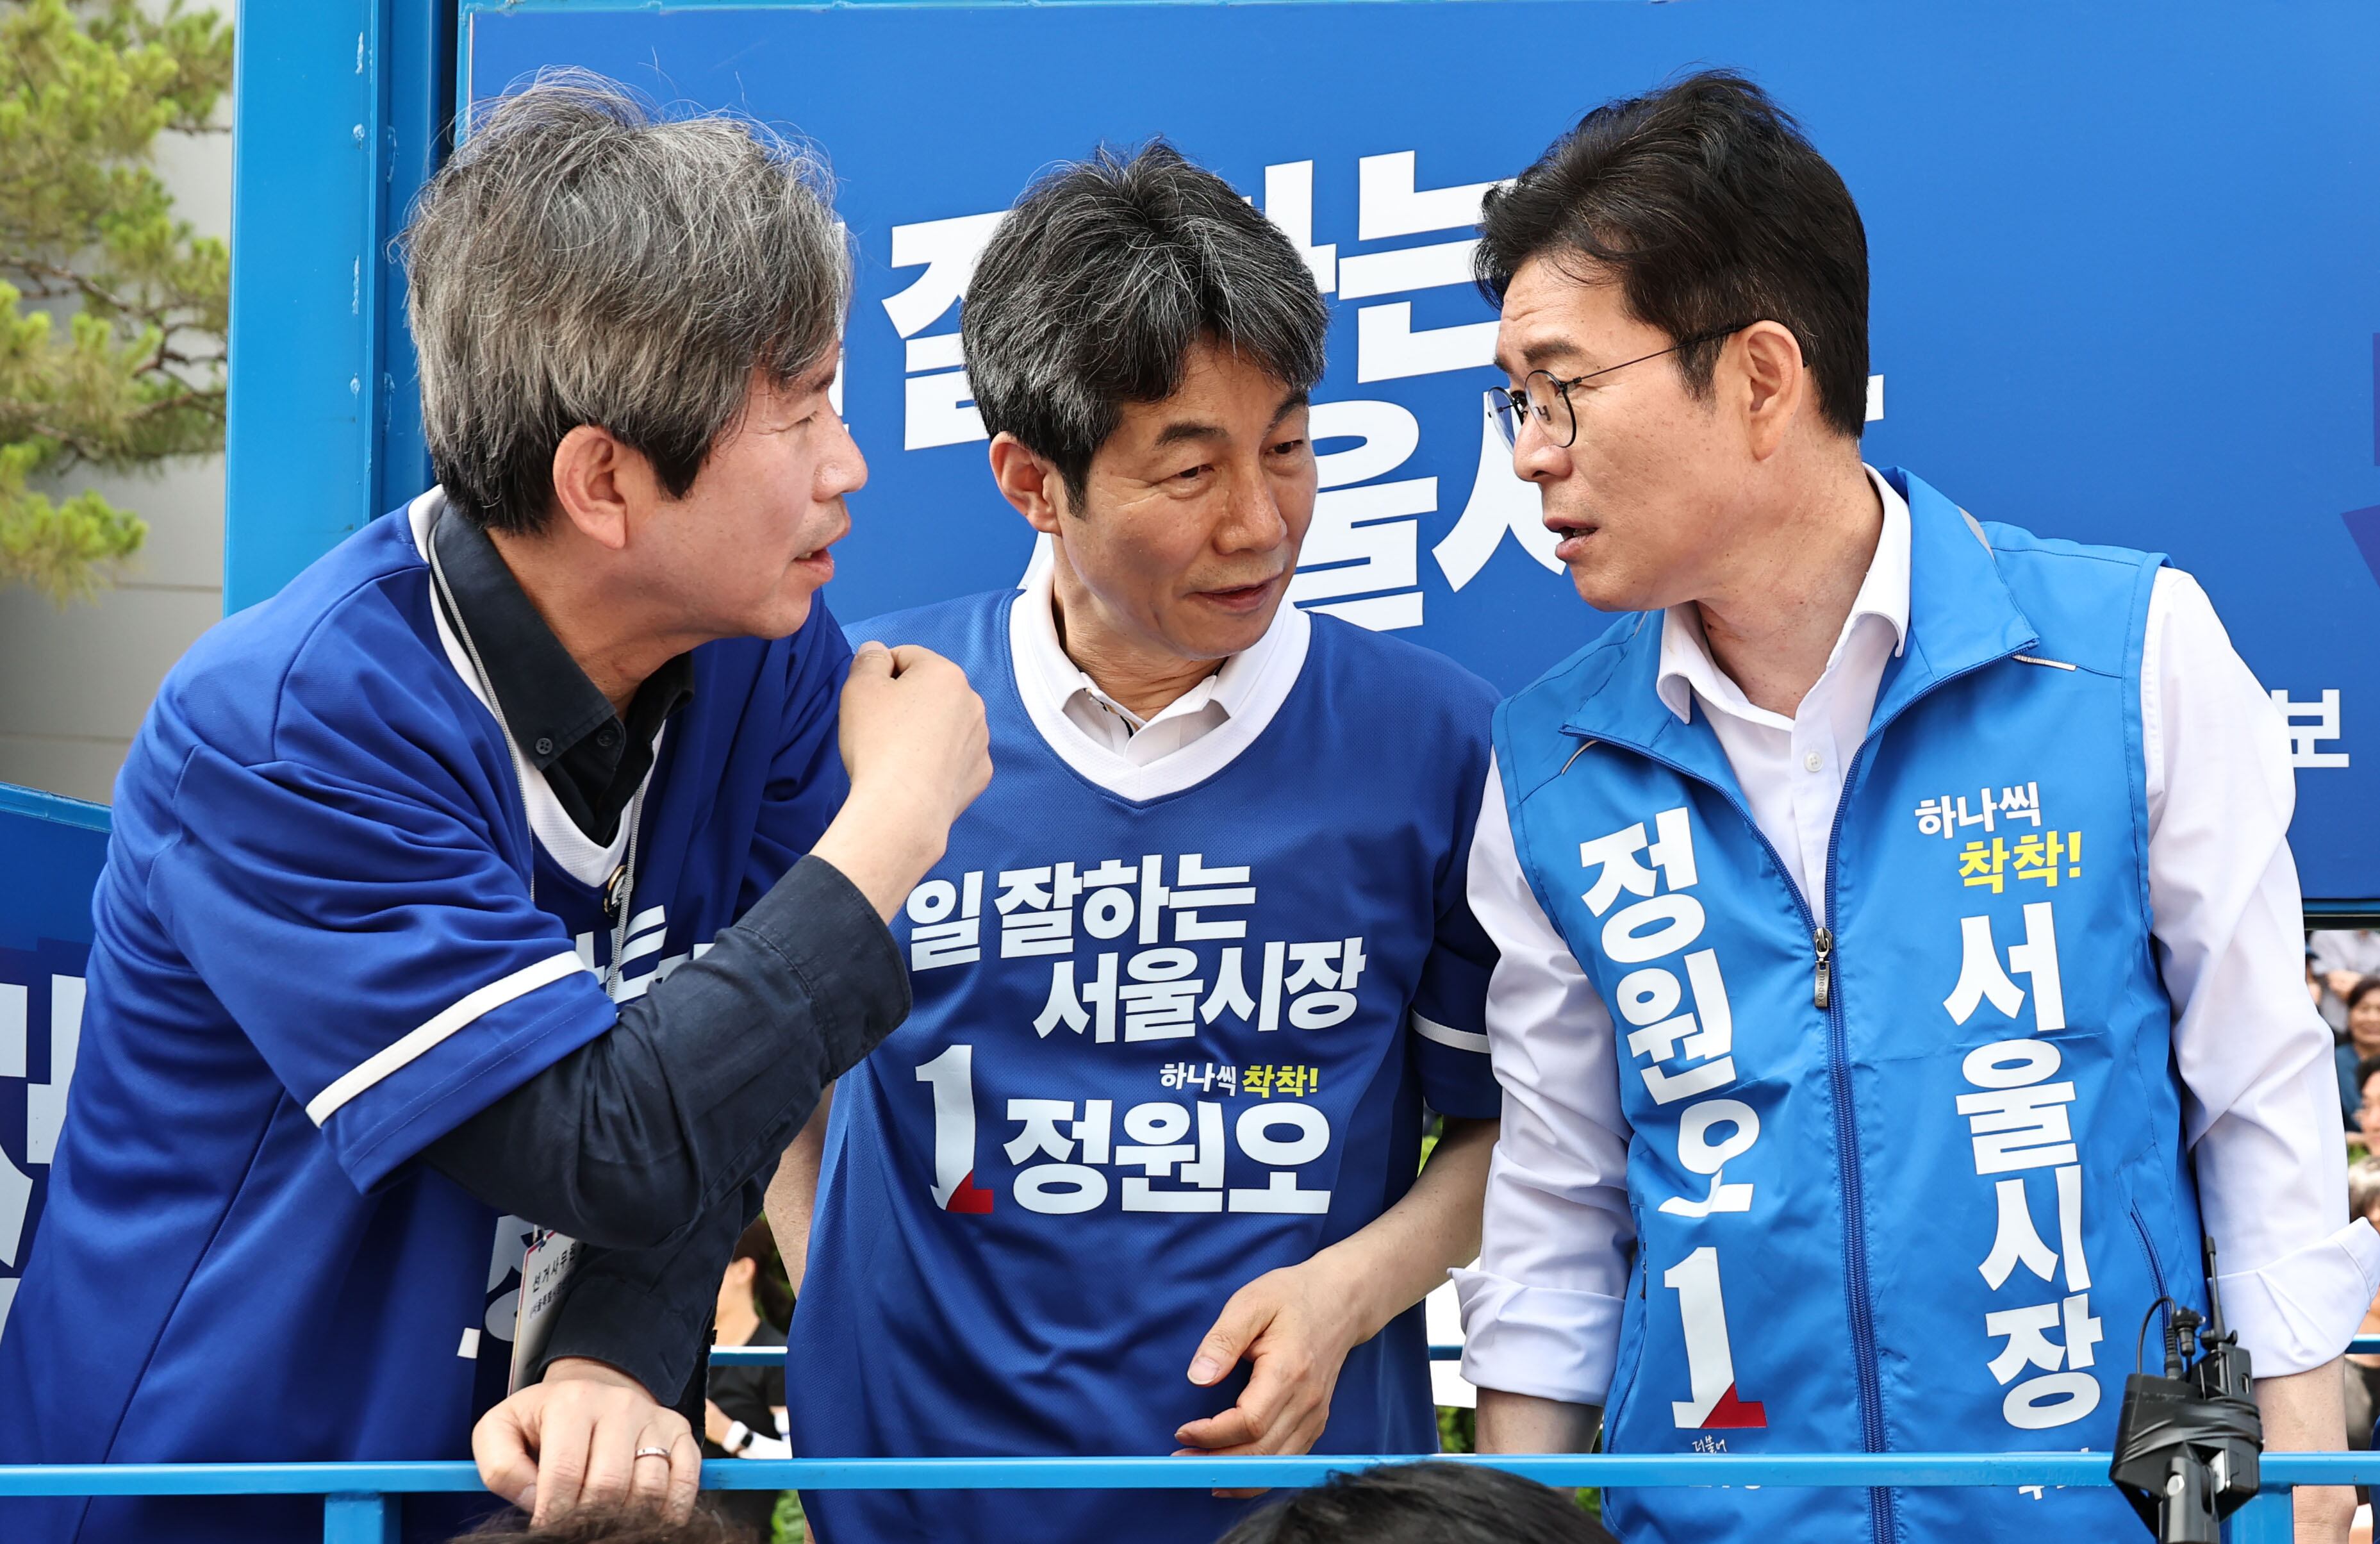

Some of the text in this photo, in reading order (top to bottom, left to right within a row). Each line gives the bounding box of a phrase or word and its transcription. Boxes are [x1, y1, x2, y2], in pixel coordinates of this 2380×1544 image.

[1915, 781, 2041, 839] 하나씩
[1958, 831, 2082, 893] 착착!
[905, 854, 1257, 972] 일 잘하는
[1032, 936, 1366, 1043] 서울시장
[1580, 808, 1760, 1218] 정원오
[916, 1045, 993, 1213] 1
[1160, 1062, 1318, 1098] 하나씩 착착!
[1003, 1099, 1331, 1214] 정원오
[1943, 902, 2103, 1429] 서울시장
[1664, 1247, 1767, 1429] 1
[1692, 1434, 1727, 1453] 더불어
